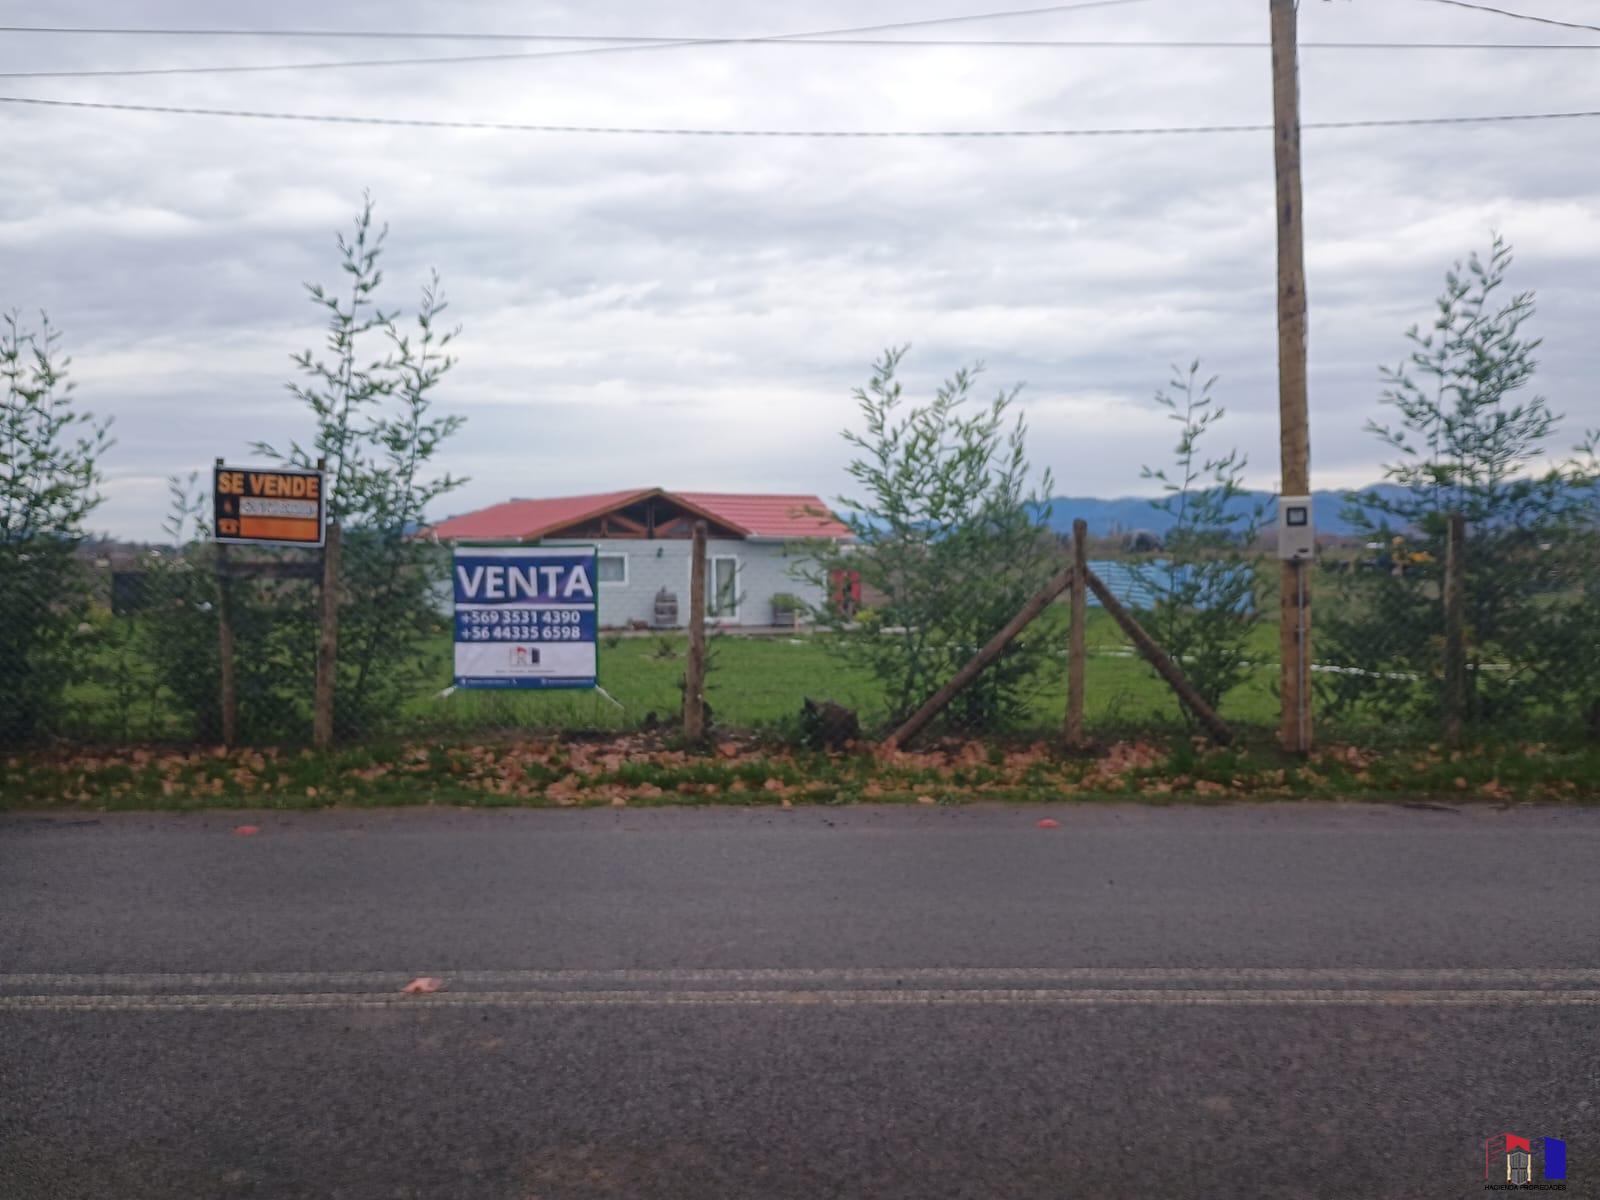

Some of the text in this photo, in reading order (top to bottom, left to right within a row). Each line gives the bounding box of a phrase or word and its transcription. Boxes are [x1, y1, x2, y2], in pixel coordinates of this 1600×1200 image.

[219, 472, 319, 498] SE VENDE
[457, 565, 593, 598] VENTA
[461, 610, 581, 625] +569 3531 4390
[461, 626, 490, 640] +56
[542, 626, 581, 640] 6598
